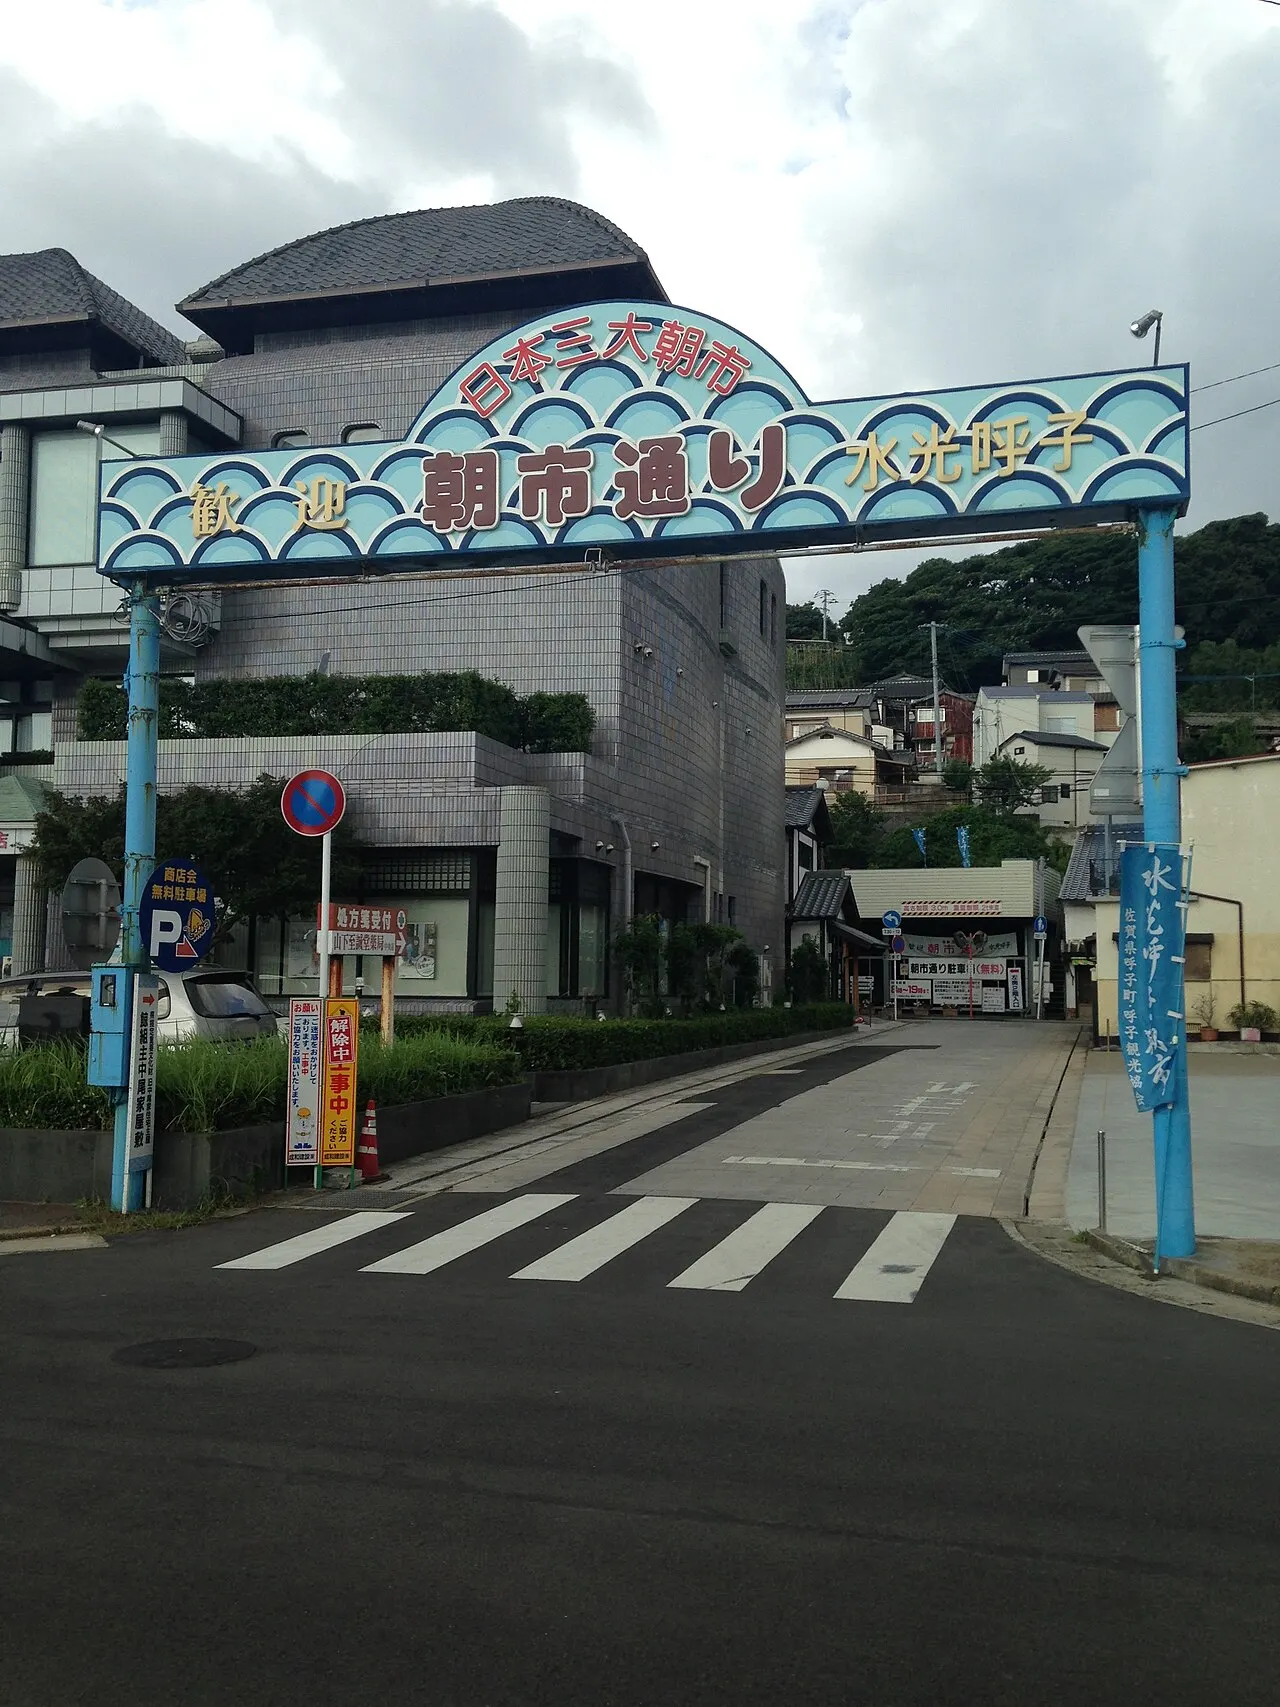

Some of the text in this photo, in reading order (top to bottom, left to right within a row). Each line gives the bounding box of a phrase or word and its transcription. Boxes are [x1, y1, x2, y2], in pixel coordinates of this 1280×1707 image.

[459, 311, 751, 418] 日本三大朝市
[845, 411, 1093, 492] 水光呼子
[421, 422, 788, 534] 朝市通り
[188, 476, 348, 539] 歓迎
[151, 883, 207, 903] 無料駐車場
[164, 867, 197, 884] 商店会
[149, 909, 182, 957] P
[337, 907, 392, 930] 処方箋受付
[294, 1002, 319, 1013] お願い
[329, 1019, 350, 1062] 解除中
[328, 1120, 337, 1150] ください
[338, 1119, 348, 1143] ご協力
